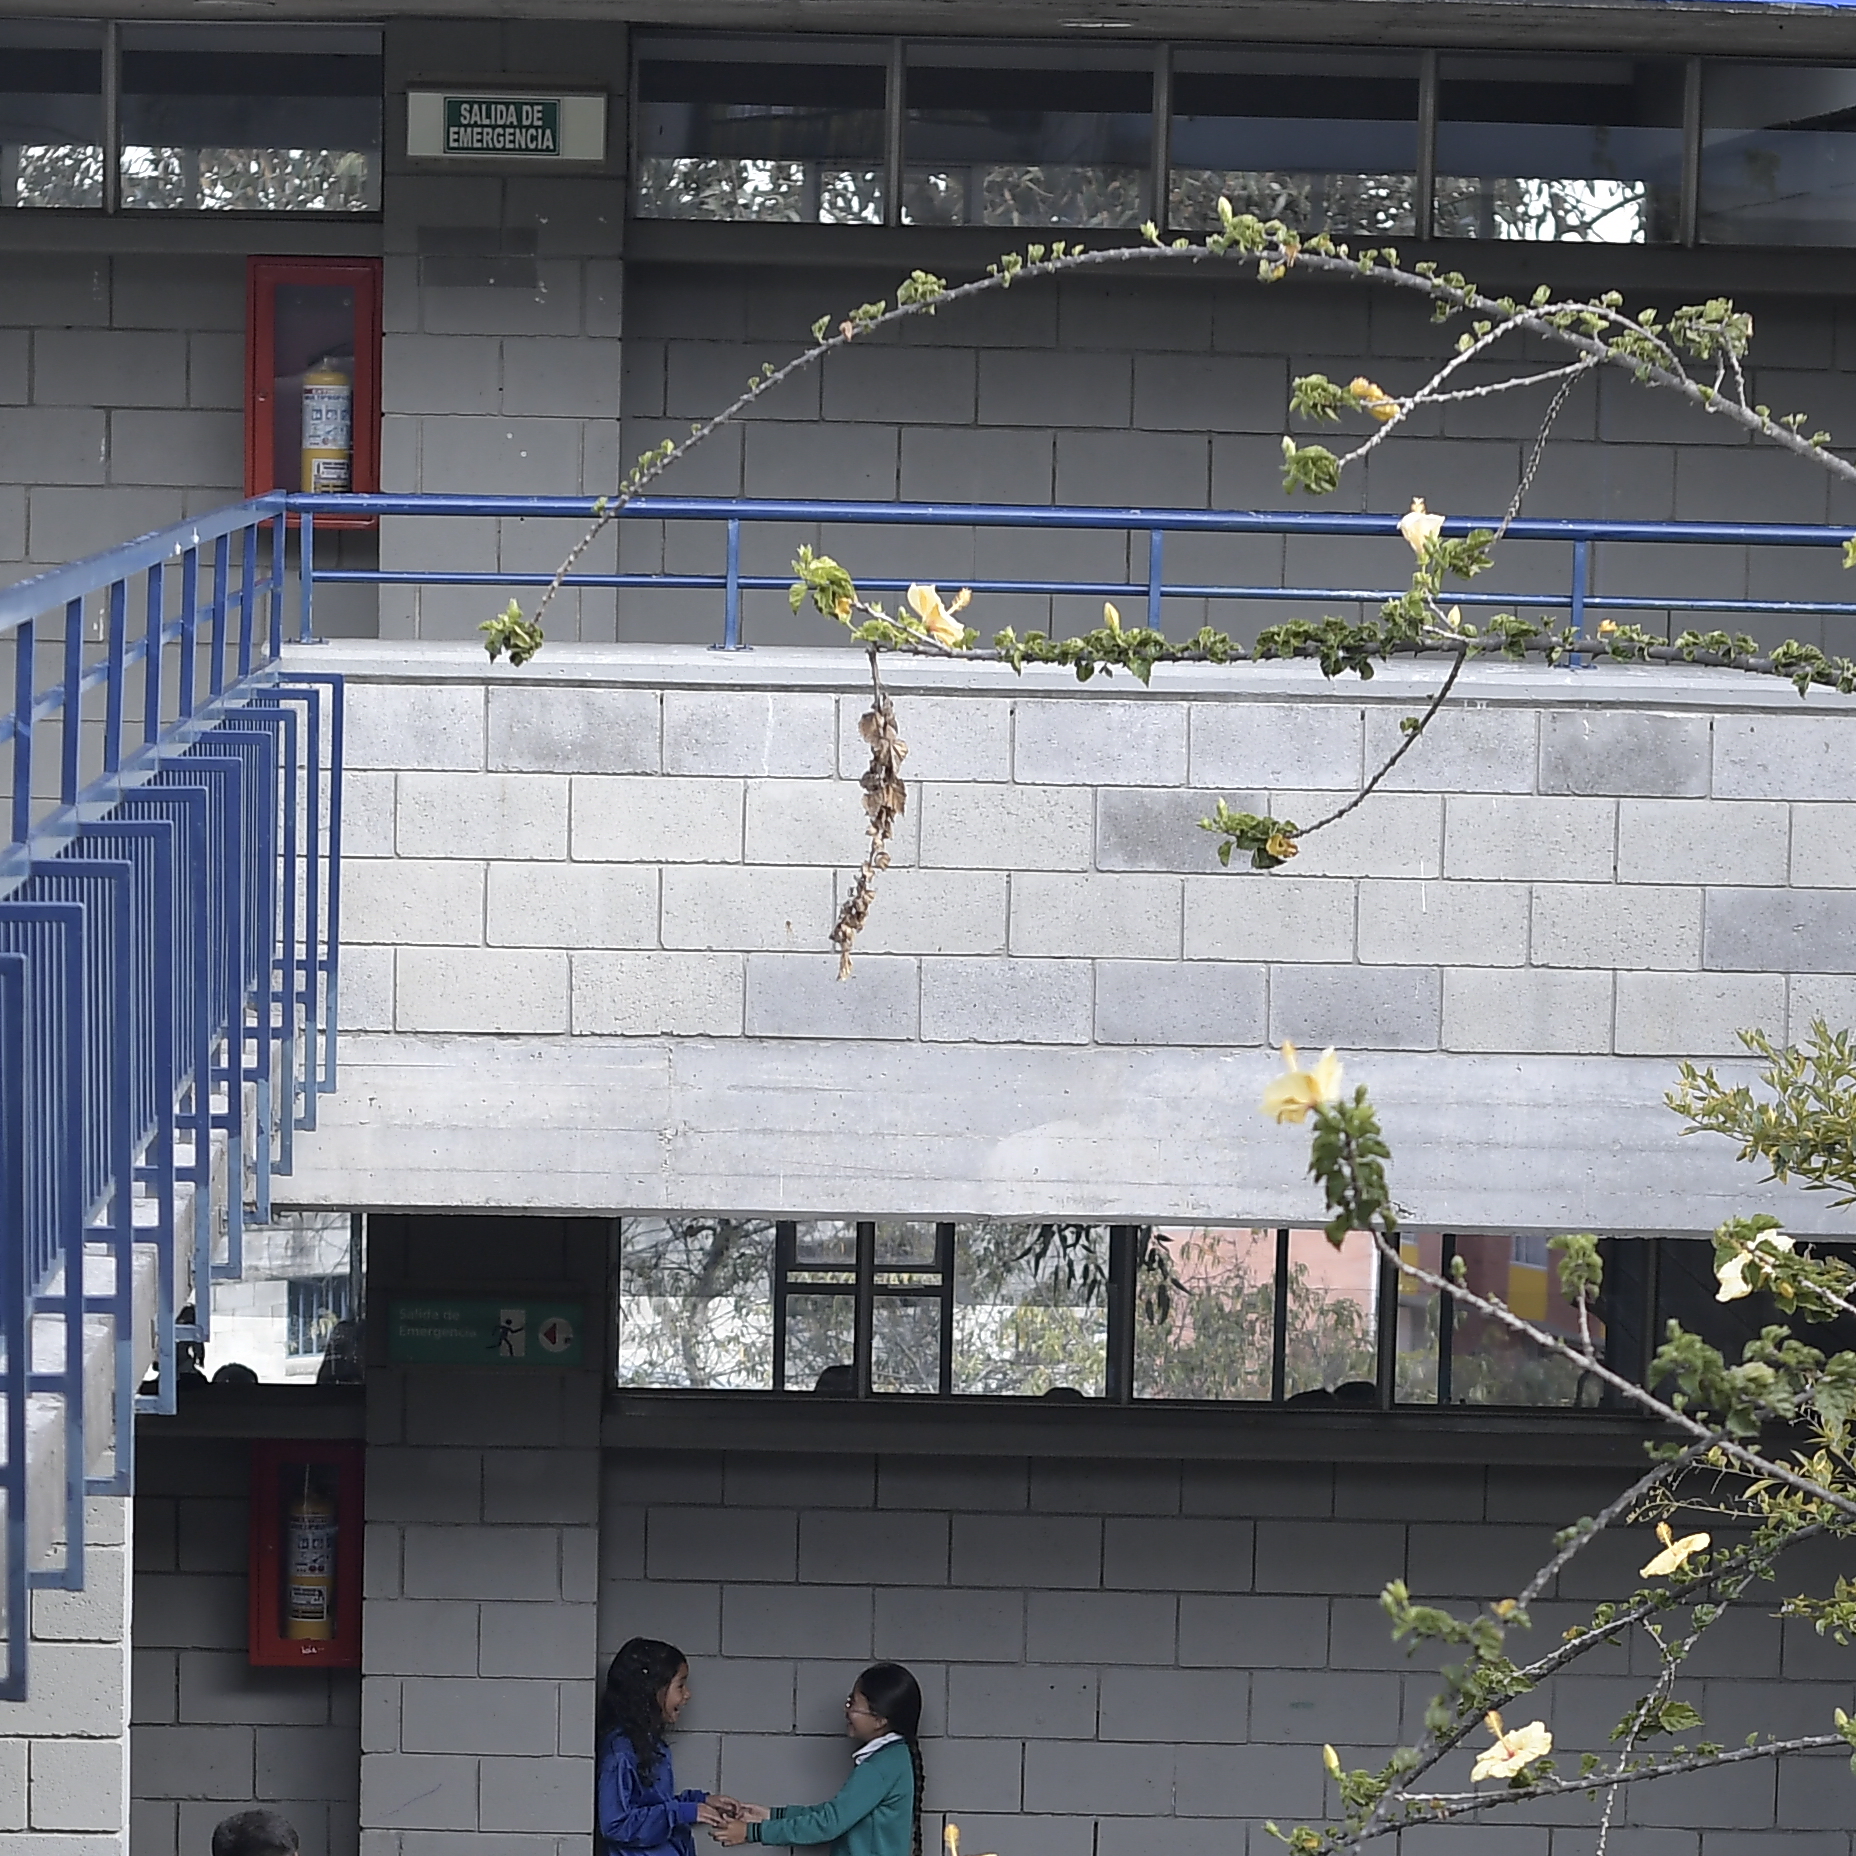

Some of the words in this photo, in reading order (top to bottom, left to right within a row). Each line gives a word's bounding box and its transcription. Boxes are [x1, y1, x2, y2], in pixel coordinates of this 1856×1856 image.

[460, 103, 517, 126] SALIDA
[522, 105, 543, 126] DE
[448, 127, 554, 150] EMERGENCIA
[399, 1308, 439, 1320] Salida
[443, 1308, 460, 1320] de
[399, 1325, 477, 1339] Emergencia
